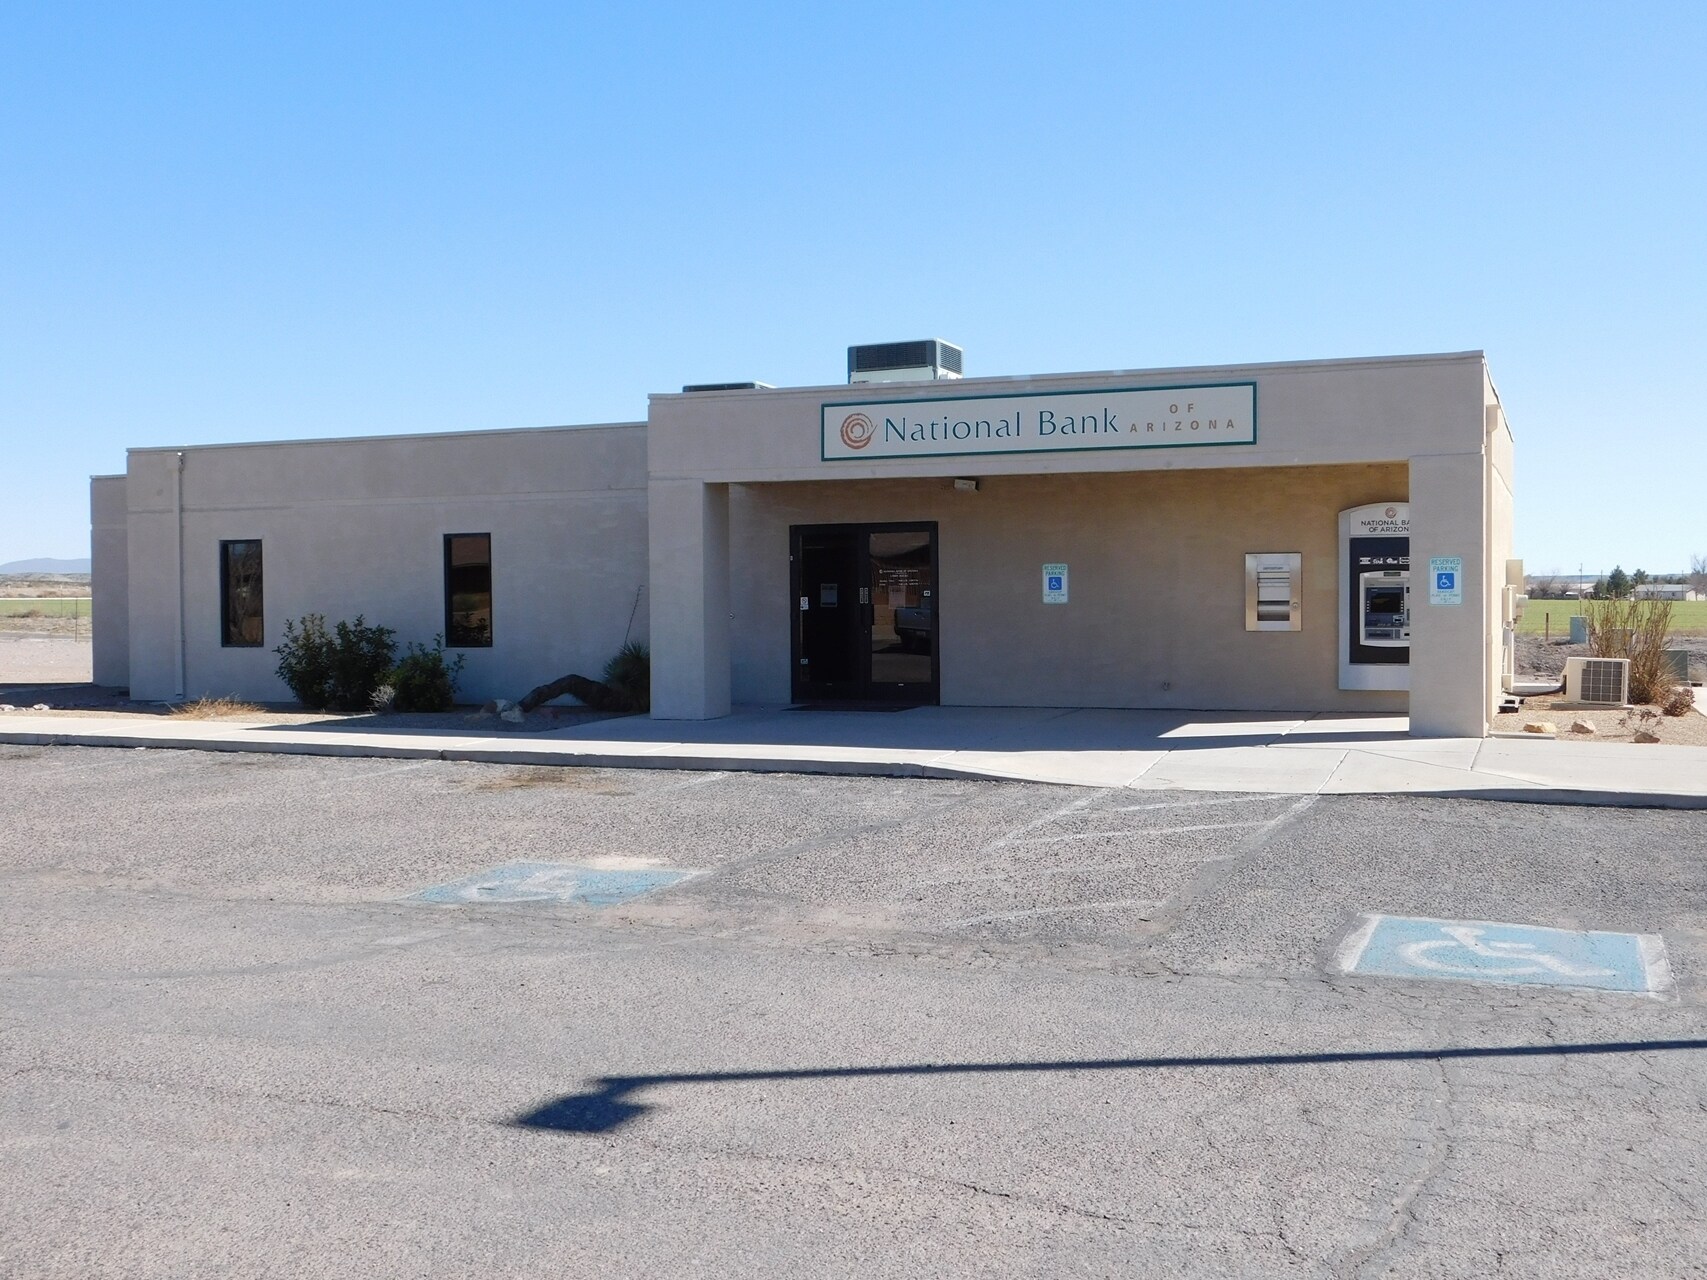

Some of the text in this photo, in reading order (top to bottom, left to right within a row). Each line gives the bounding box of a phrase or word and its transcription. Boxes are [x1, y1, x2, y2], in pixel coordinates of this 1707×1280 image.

[1169, 403, 1194, 414] OF
[885, 407, 1119, 442] National Bank
[1129, 418, 1235, 433] ARIZONA
